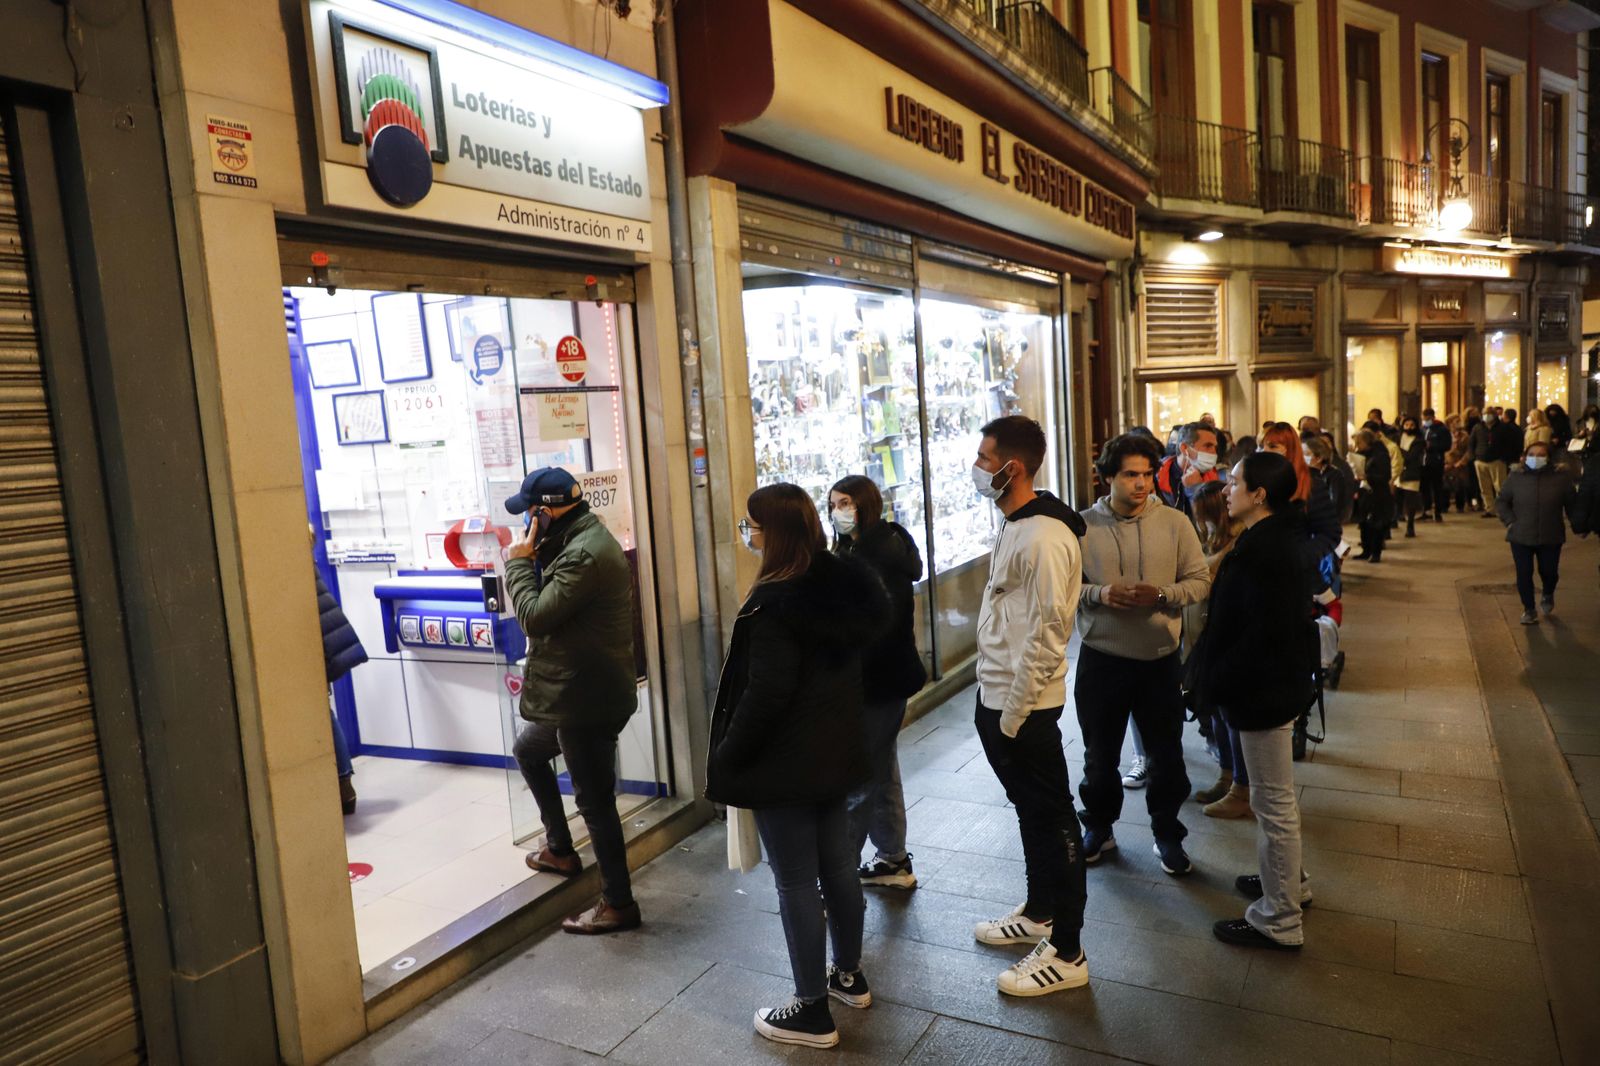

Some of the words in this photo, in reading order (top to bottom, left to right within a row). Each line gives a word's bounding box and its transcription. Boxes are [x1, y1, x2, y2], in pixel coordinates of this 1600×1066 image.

[451, 82, 536, 129] Loterías
[541, 114, 552, 139] y
[884, 86, 965, 164] LIBRERIA
[980, 121, 1010, 185] EL
[458, 134, 553, 178] Apuestas
[557, 158, 584, 186] del
[587, 166, 643, 199] Estado
[497, 202, 611, 240] Administración
[636, 227, 645, 245] 4
[560, 339, 580, 356] +18
[393, 394, 443, 412] 12061
[583, 474, 618, 489] PREMIO
